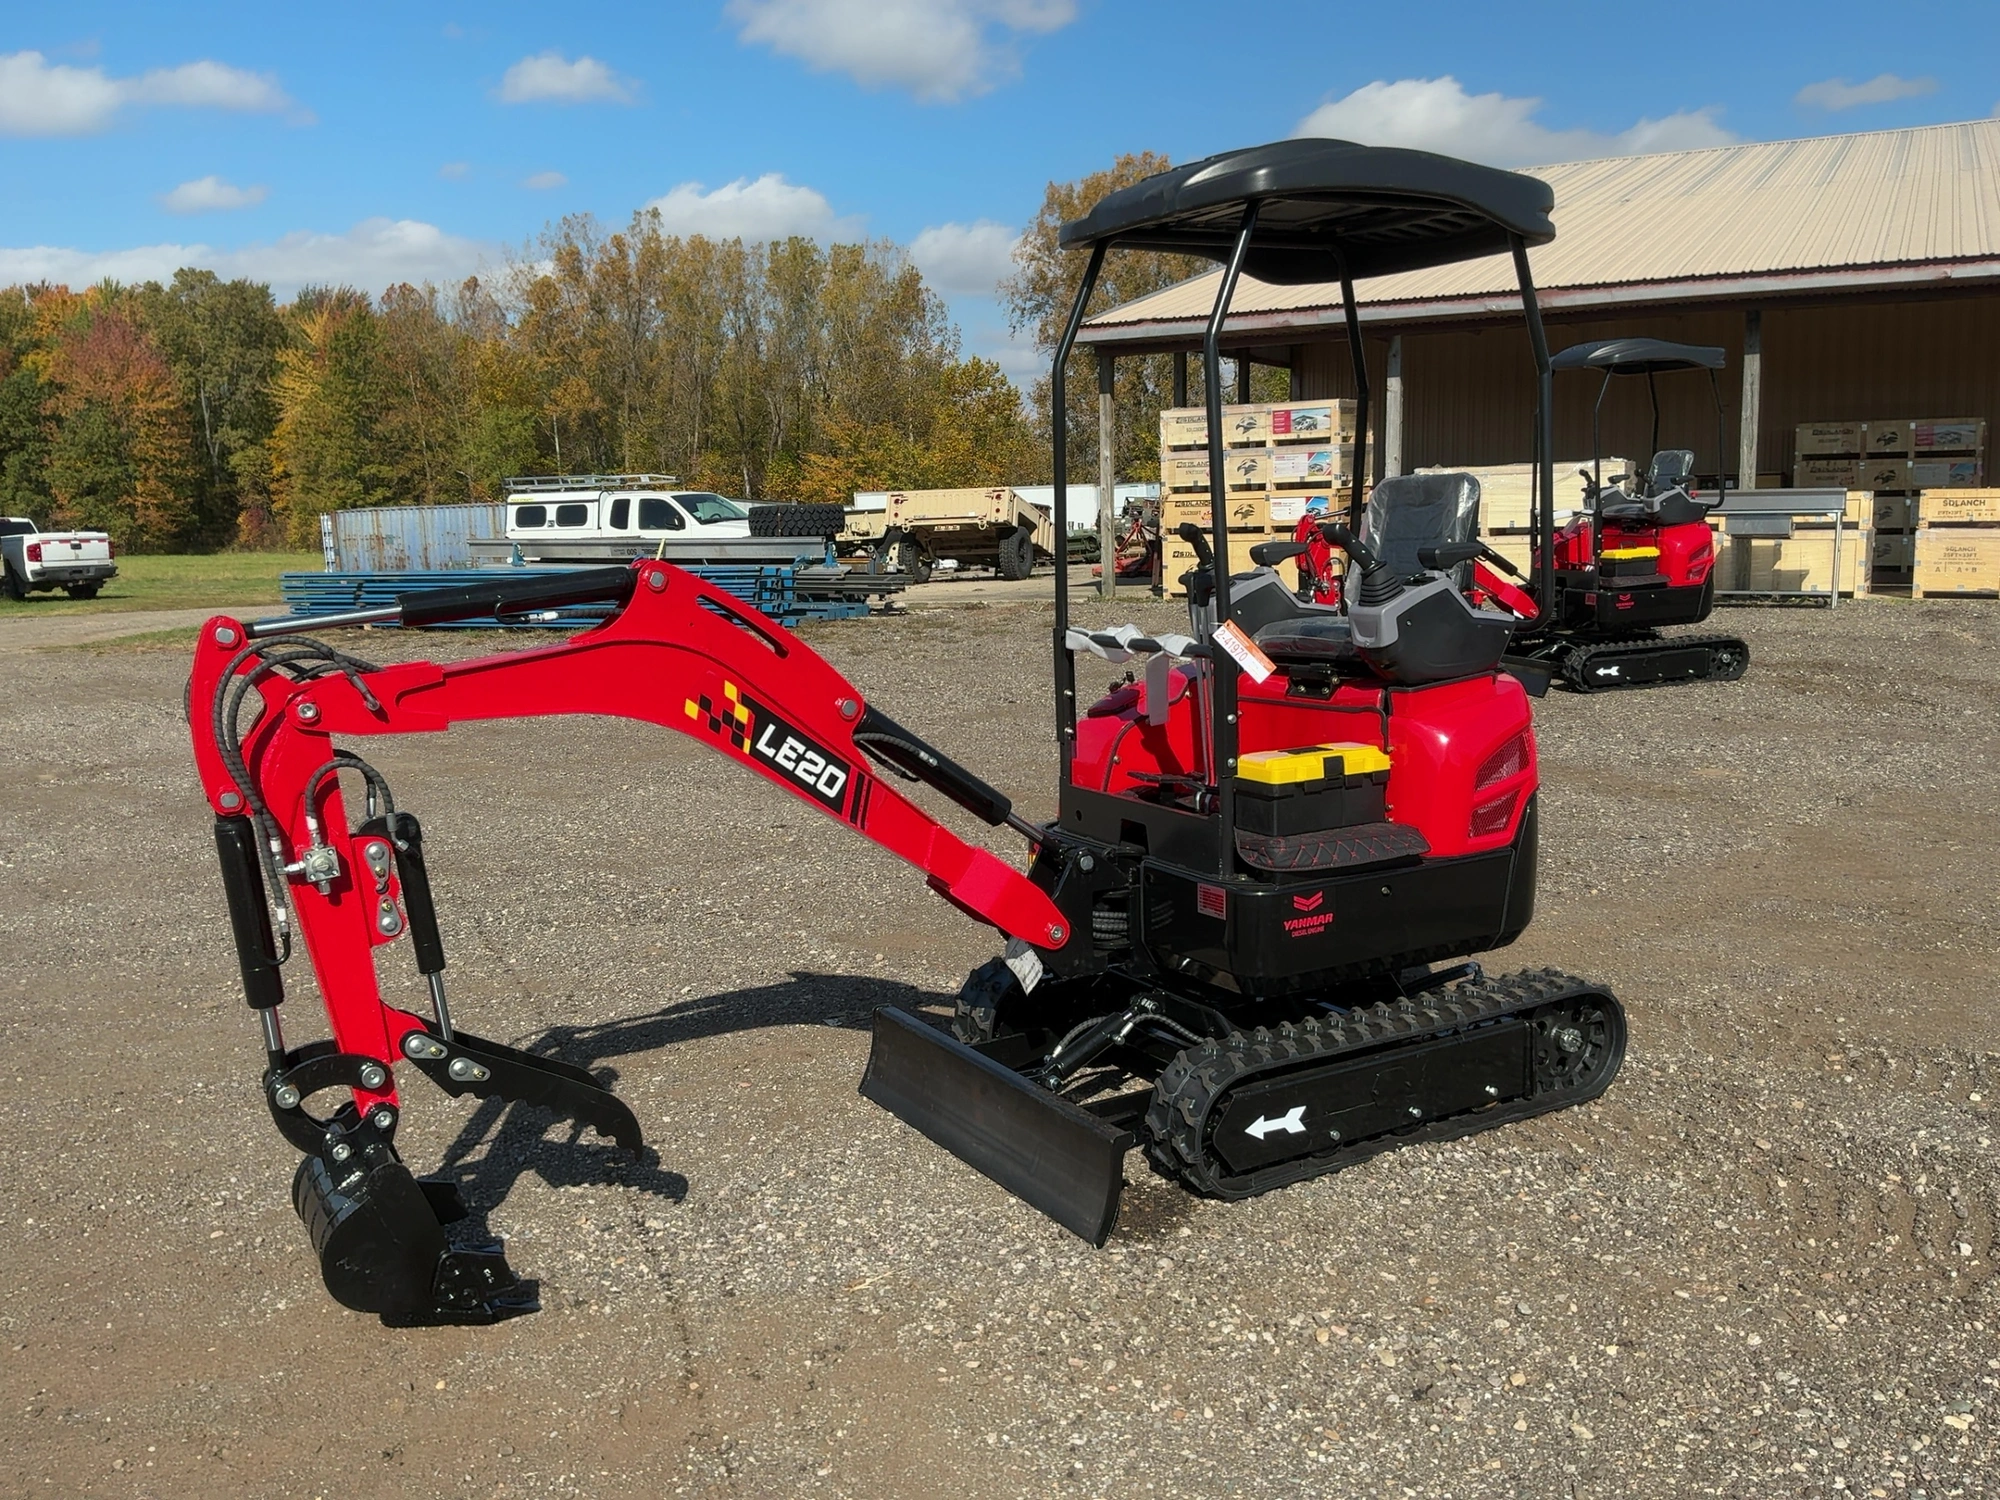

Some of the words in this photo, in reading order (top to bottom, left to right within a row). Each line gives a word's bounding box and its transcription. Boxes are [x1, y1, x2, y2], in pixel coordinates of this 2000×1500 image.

[1215, 629, 1249, 662] 2-41970
[756, 723, 847, 798] LE20
[1283, 912, 1333, 931] YANMAR
